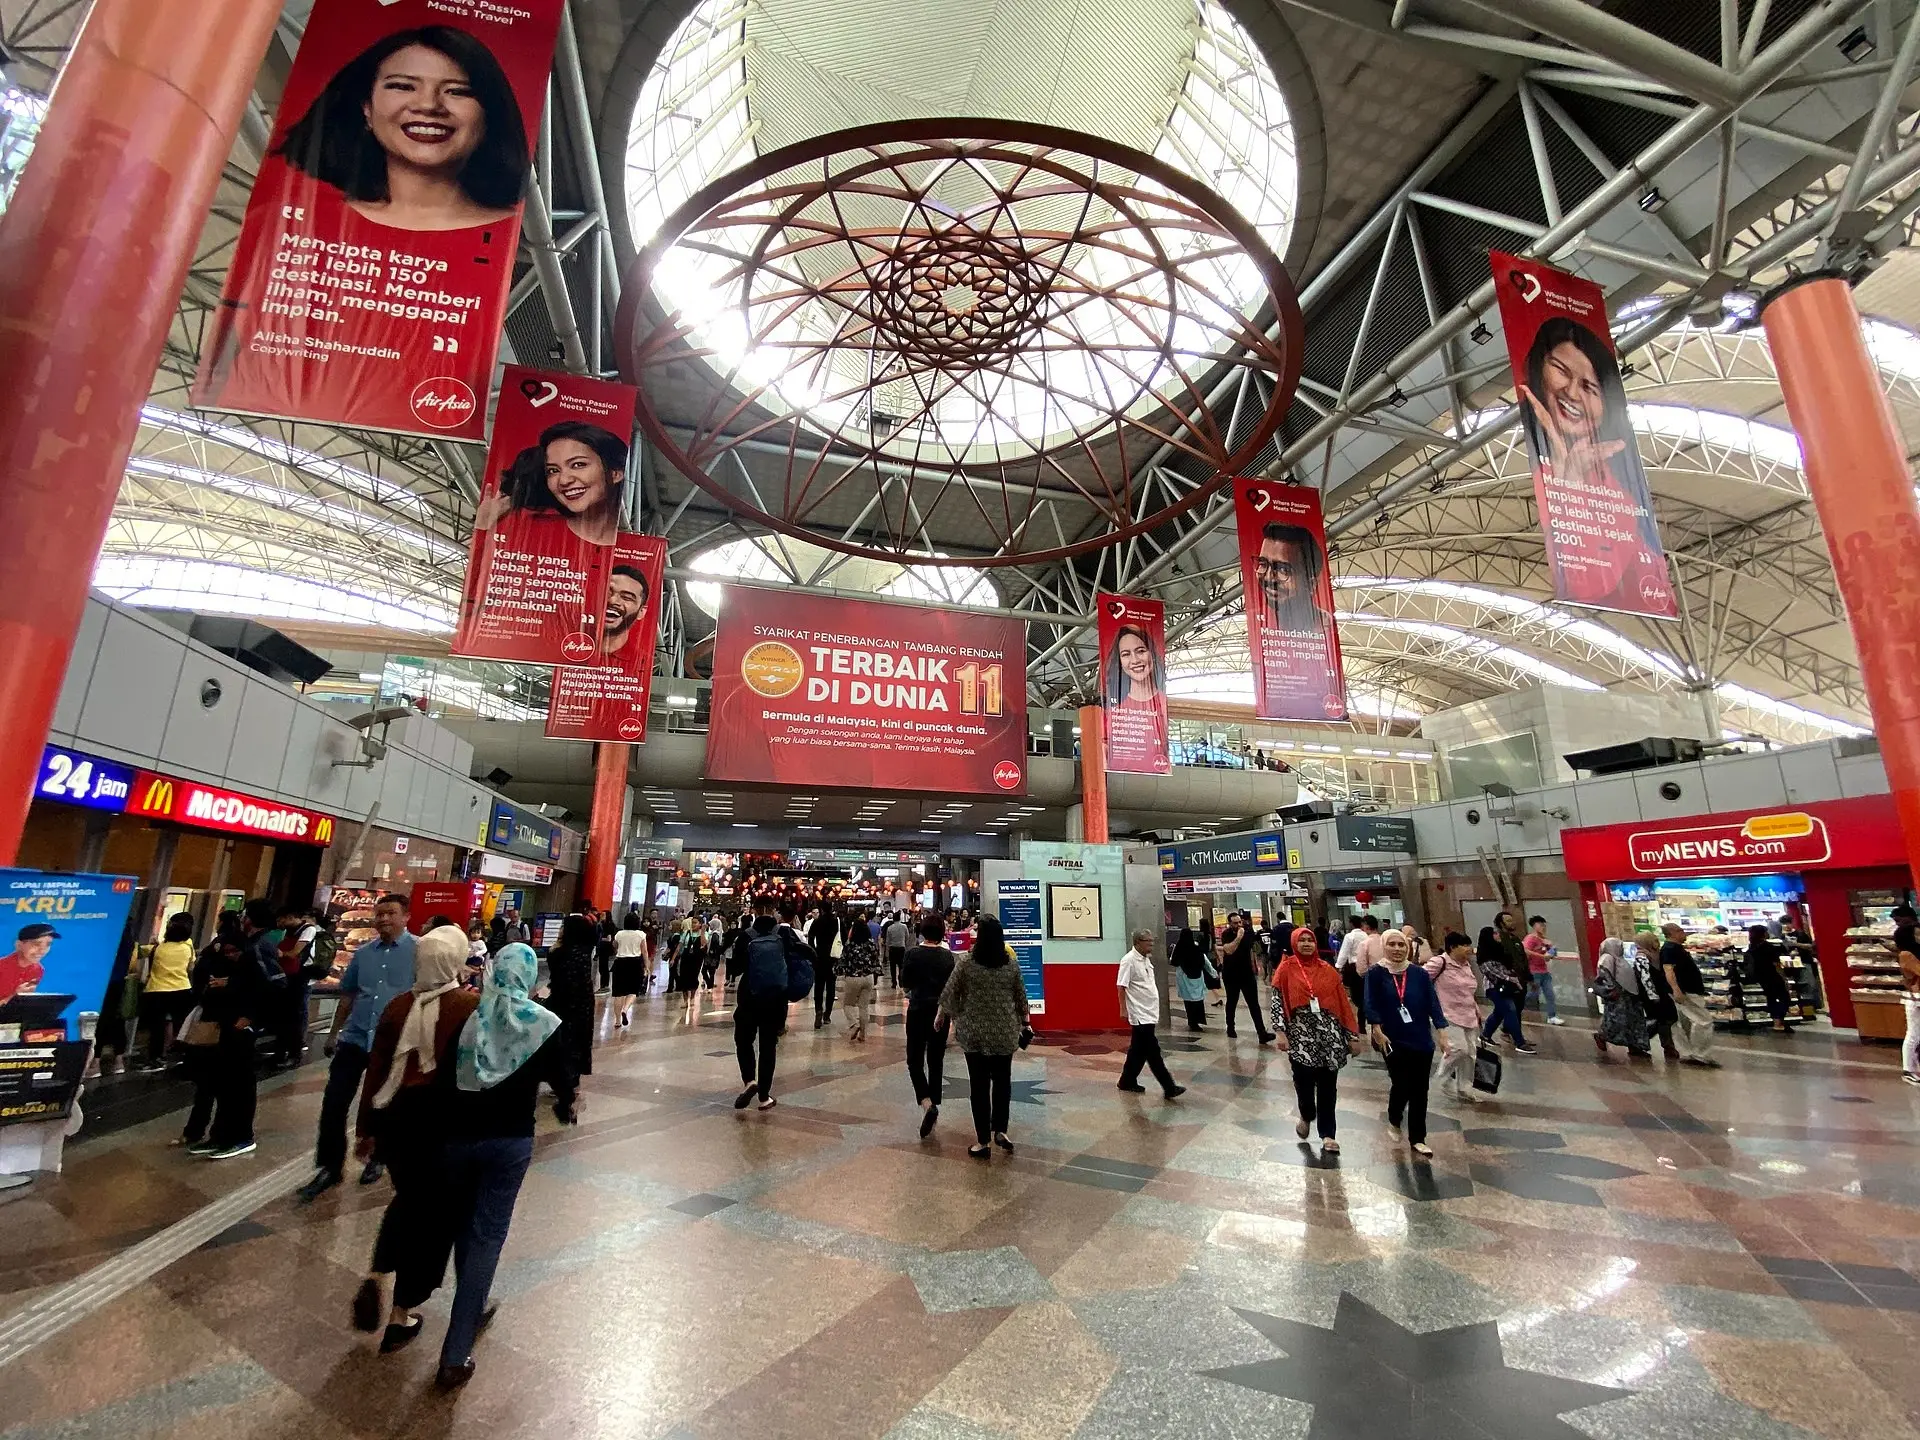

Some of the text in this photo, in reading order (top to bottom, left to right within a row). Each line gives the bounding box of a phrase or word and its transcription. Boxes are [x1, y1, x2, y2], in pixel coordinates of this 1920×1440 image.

[428, 0, 513, 25] Meets Travel
[480, 1, 530, 18] Passion
[281, 232, 448, 272] Mencipta karya
[276, 251, 428, 285] dari lebih 150
[271, 267, 481, 310] destinasi. Memberi
[262, 298, 345, 324] impian.
[266, 282, 468, 326] ilham, menggapai
[250, 343, 330, 362] Copywriting
[253, 331, 400, 360] Alisha Shaharuddin
[560, 402, 609, 416] Meets Travel
[561, 394, 618, 410] Where Passion
[1543, 473, 1624, 500] Merealisasikan
[1545, 488, 1648, 518] impian menjelajah
[1548, 504, 1616, 526] ke lebih 150
[1550, 517, 1634, 544] destinasi sejak
[1554, 531, 1586, 548] 2001.
[494, 549, 570, 568] Karier yang
[492, 561, 588, 581] hebat, pejabat
[487, 584, 585, 604] kerja jadi lebih
[489, 574, 582, 594] yang seronok,
[485, 596, 558, 613] bermakna!
[754, 626, 1004, 660] SYARIKAT PENERBANGAN TAMBANG RENDAH
[1261, 628, 1326, 640] Memudahkan
[1262, 638, 1326, 651] penerbangan
[810, 646, 949, 684] TERBAIK
[1263, 648, 1326, 662] anda, impian
[1264, 659, 1291, 669] kami.
[561, 680, 644, 692] Malaysia bersama
[562, 672, 638, 684] membawa nama
[560, 688, 634, 700] ke serata dunia.
[808, 678, 840, 703] DI
[850, 681, 949, 712] DUNIA
[954, 662, 1003, 717] 11
[762, 710, 988, 736] Bermula di Malaysia, kini di puncak dunia.
[769, 736, 976, 756] yang luar biasa bersama-sama. Terima kasih, Malaysia.
[786, 726, 965, 746] Dengan sokongan anda, kami berjaya ke tahap
[42, 754, 128, 799] 24 jam
[186, 790, 310, 836] McDonald's
[1191, 848, 1252, 866] KTM Komuter
[16, 897, 76, 913] KRU
